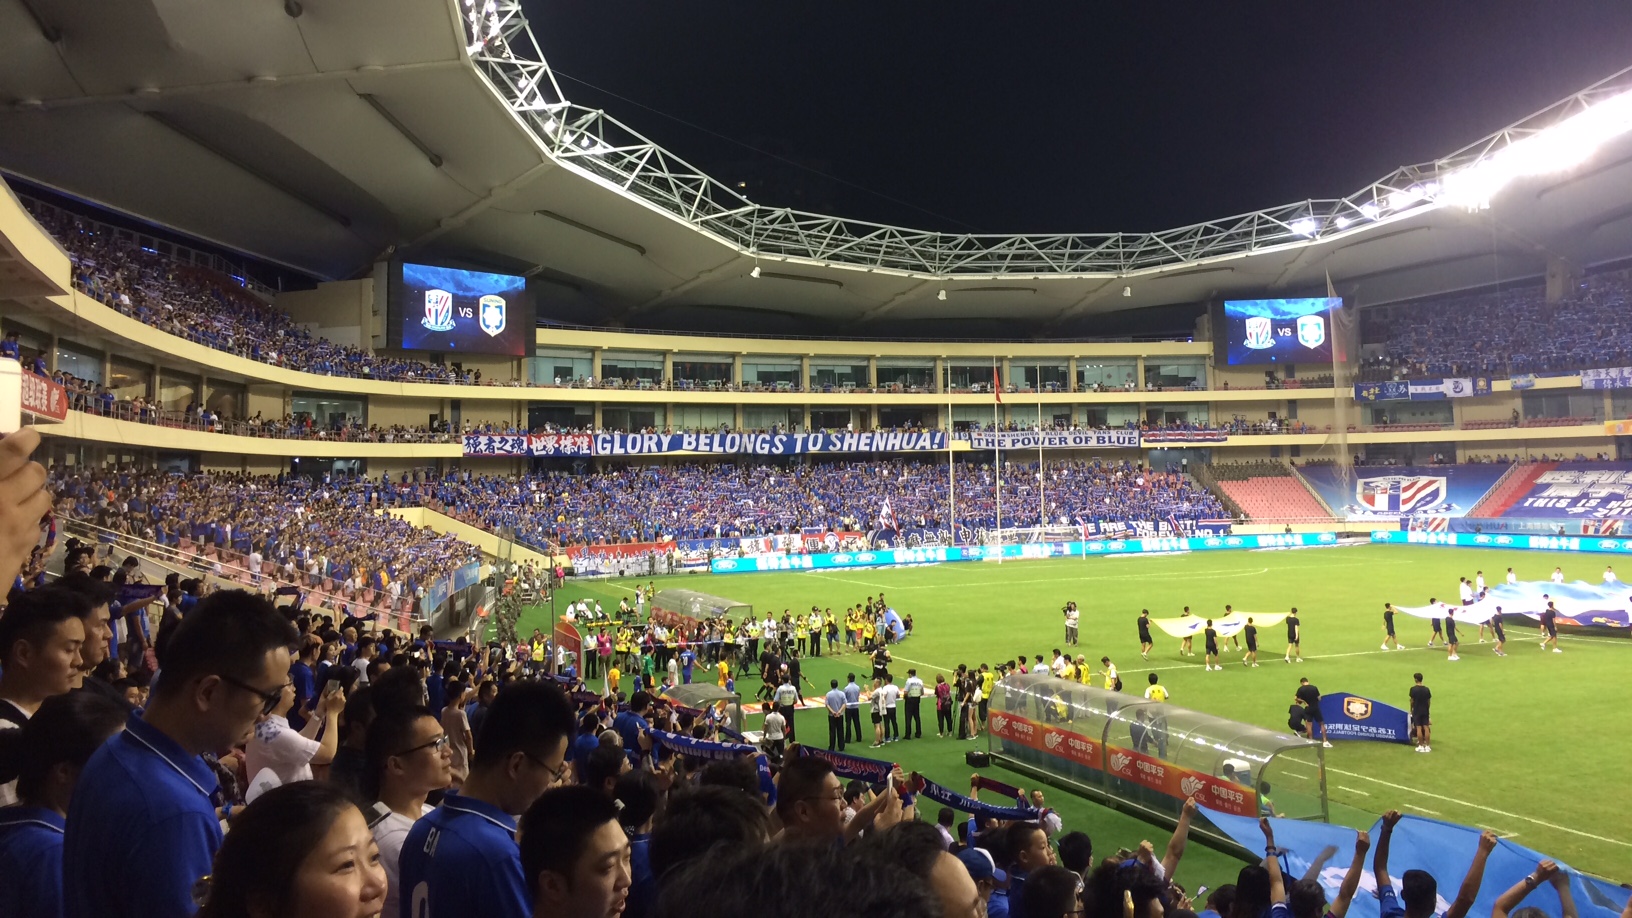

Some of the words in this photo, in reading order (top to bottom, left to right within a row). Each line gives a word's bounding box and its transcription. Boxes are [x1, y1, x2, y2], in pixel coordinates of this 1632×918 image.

[458, 306, 473, 319] VS
[1277, 327, 1292, 337] VS
[597, 433, 673, 455] GLORY
[682, 433, 788, 454] BELONGS
[794, 432, 824, 453] TO
[828, 432, 942, 451] SHENHUA!
[974, 437, 1006, 448] THE
[1011, 436, 1068, 448] POWER
[1072, 436, 1093, 446] OF
[1096, 435, 1137, 445] BLUE
[1523, 498, 1572, 508] THIS
[1576, 499, 1602, 507] IS
[1100, 521, 1128, 532] ARE
[1128, 519, 1148, 530] THE
[1001, 728, 1010, 736] CSL
[1011, 720, 1034, 735] 中国平安
[1055, 744, 1066, 754] CSL
[1068, 737, 1094, 754] 中国平安
[1121, 766, 1134, 777] CSL
[1136, 759, 1165, 778] 中国平安
[1194, 791, 1208, 802] CSL
[1211, 784, 1244, 805] 中国平安
